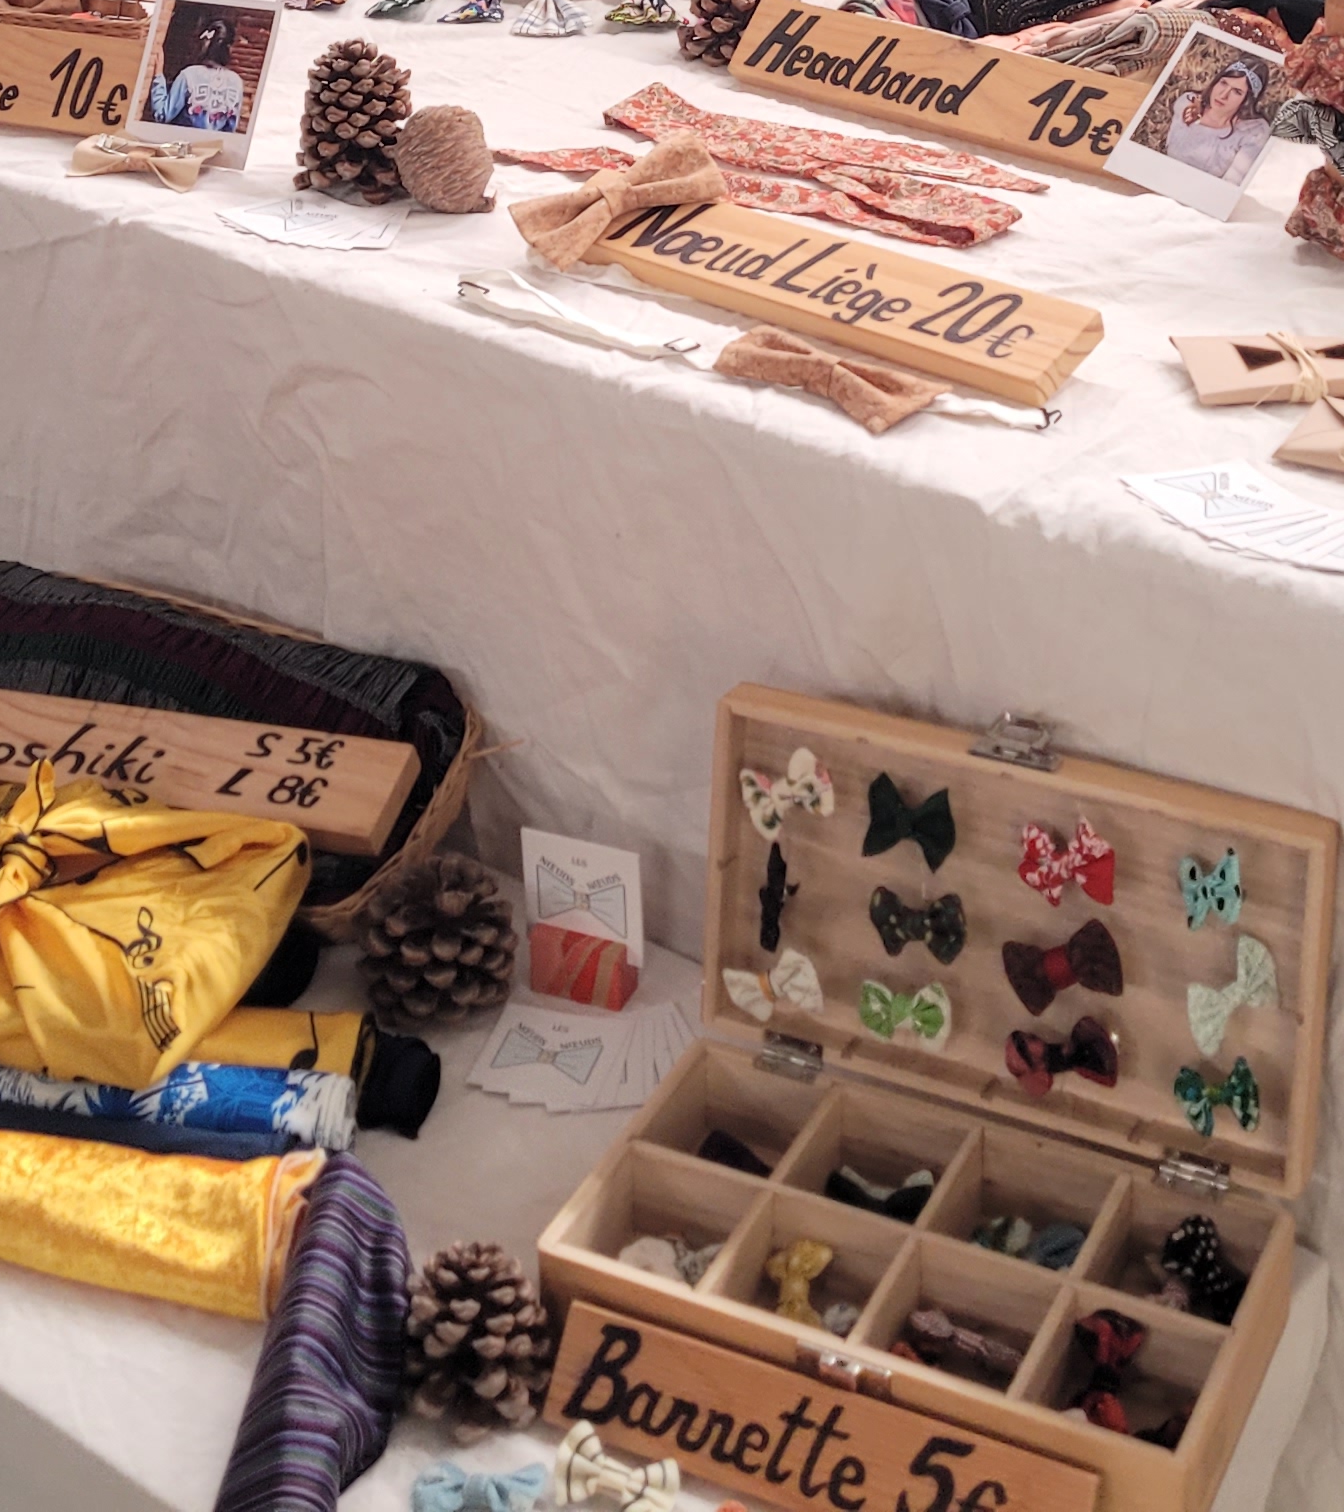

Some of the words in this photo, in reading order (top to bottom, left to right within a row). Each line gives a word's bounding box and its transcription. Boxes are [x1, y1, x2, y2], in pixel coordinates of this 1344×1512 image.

[49, 47, 128, 127] 10€
[744, 8, 999, 116] Headband
[1028, 78, 1123, 156] 15€
[775, 241, 912, 325] Liège
[908, 281, 1036, 359] 20€
[215, 768, 254, 796] L
[267, 775, 329, 808] 8€
[244, 732, 284, 758] S
[286, 737, 345, 770] 5€
[562, 1324, 866, 1511] Barrette
